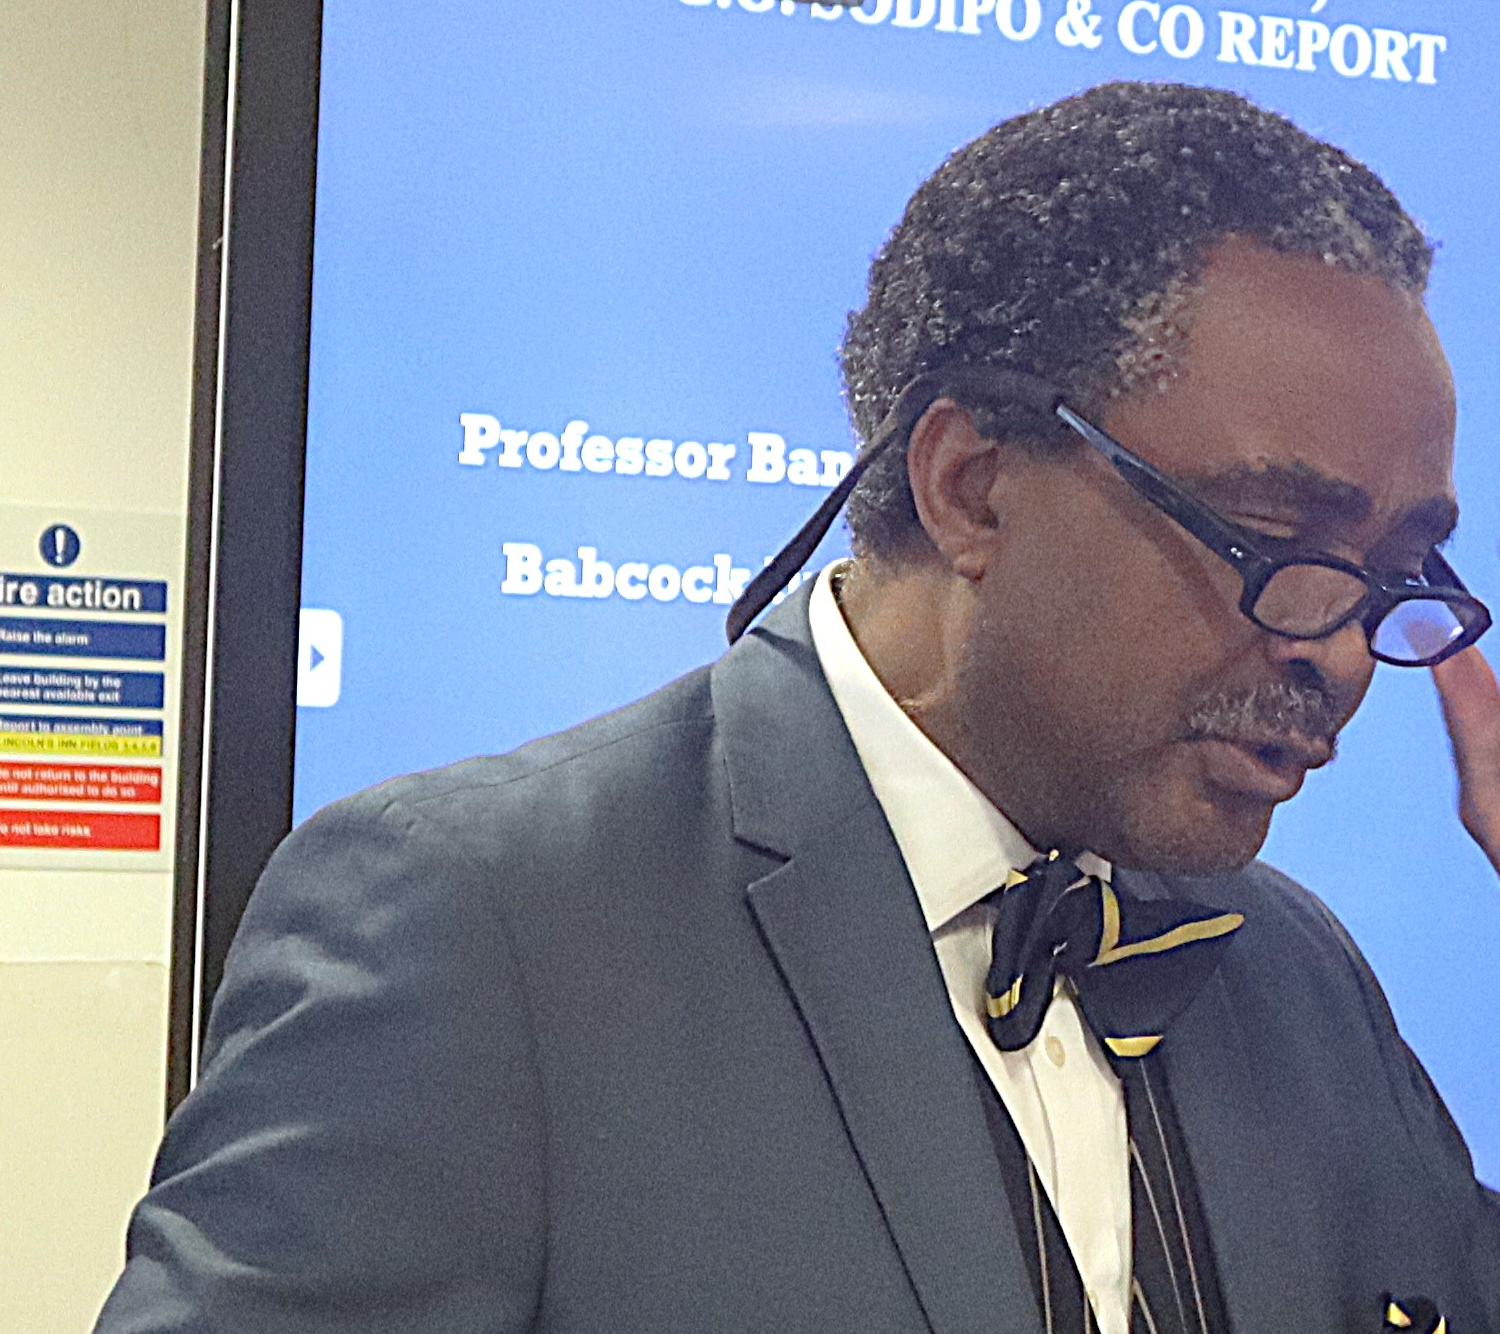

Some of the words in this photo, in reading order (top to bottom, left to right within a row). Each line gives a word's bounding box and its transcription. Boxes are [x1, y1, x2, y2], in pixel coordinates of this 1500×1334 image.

[1117, 0, 1205, 60] CO
[1217, 10, 1447, 85] REPORT
[458, 412, 736, 481] Professor
[501, 542, 751, 604] Babcock
[47, 580, 141, 610] action
[33, 630, 52, 644] the
[54, 632, 89, 645] alarm
[33, 672, 82, 688] building
[85, 675, 99, 690] by
[102, 676, 122, 688] the
[43, 689, 96, 702] available
[98, 691, 120, 703] exit
[12, 768, 32, 780] not
[35, 769, 71, 781] return
[74, 769, 87, 782] to
[89, 770, 108, 782] the
[111, 771, 159, 786] building
[87, 785, 99, 796] to
[102, 785, 118, 797] do
[11, 822, 30, 835] not
[33, 823, 59, 836] take
[61, 825, 92, 837] risks
